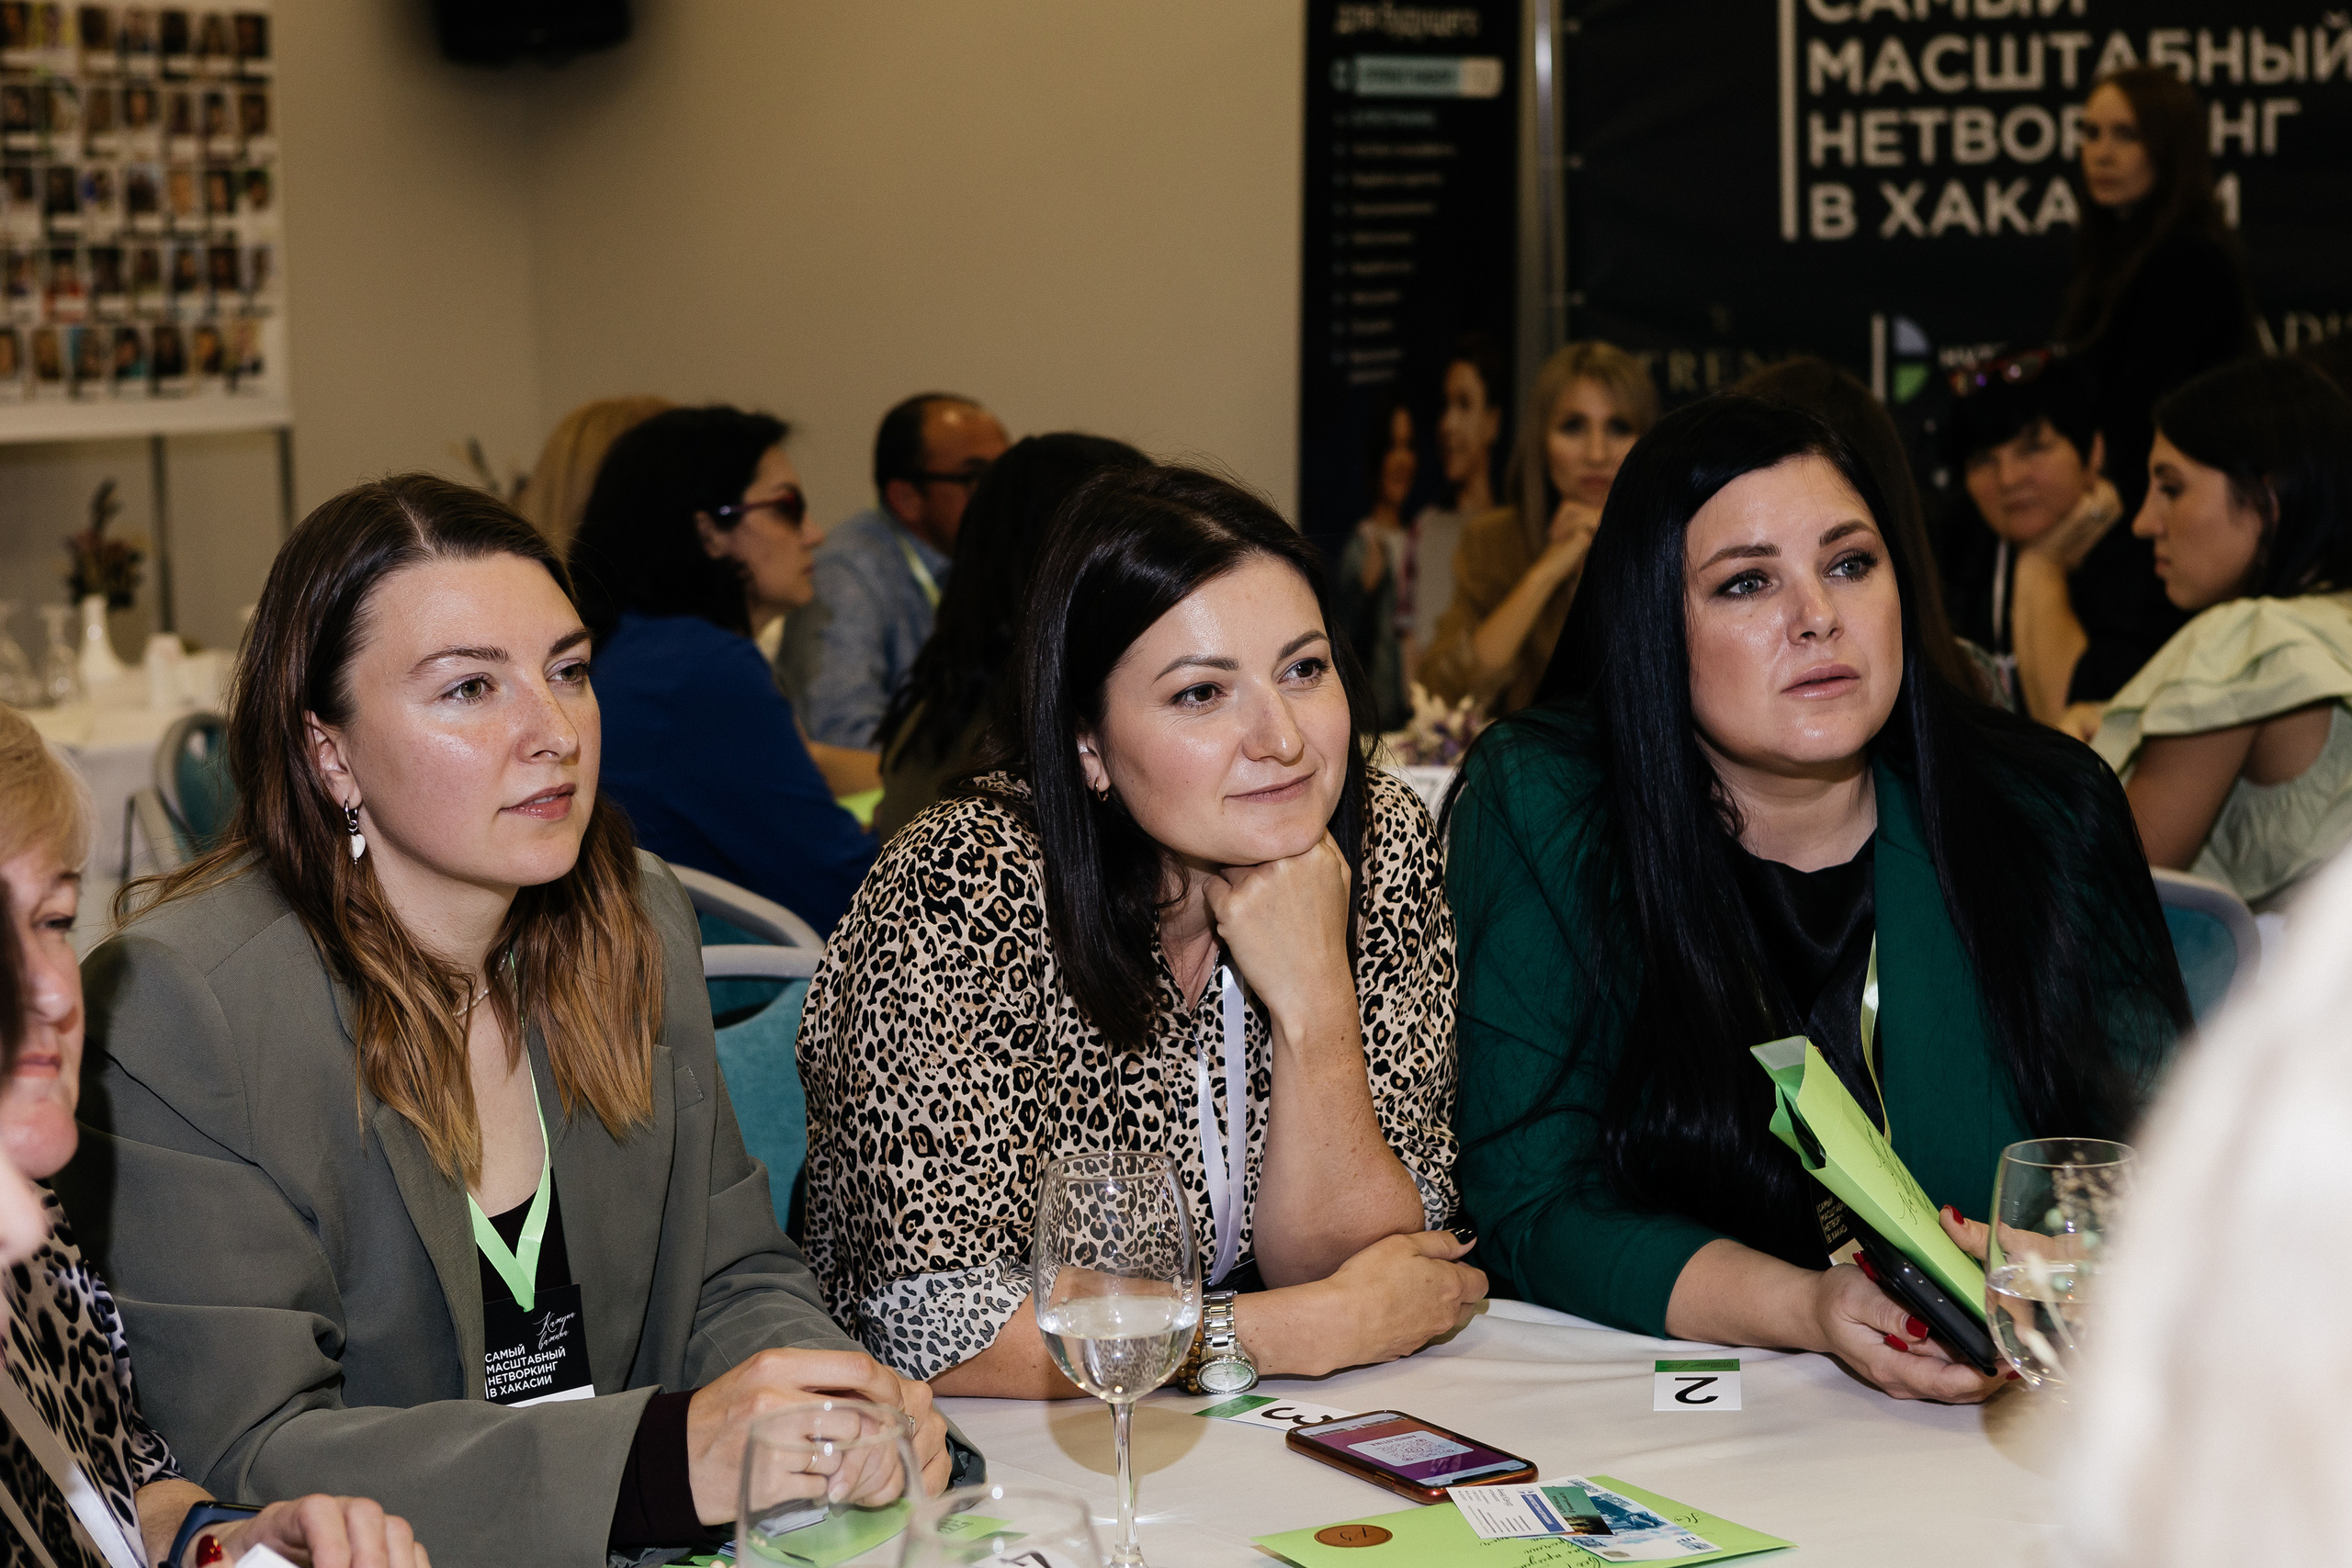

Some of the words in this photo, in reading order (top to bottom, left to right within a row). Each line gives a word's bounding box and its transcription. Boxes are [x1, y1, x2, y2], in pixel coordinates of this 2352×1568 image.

[1806, 11, 2352, 95] МАСШТАБНЫЙ
[1808, 97, 2301, 168] НЕТВОРНГ
[1808, 182, 1859, 241] В
[1880, 172, 2242, 239] ХАКАИ
[485, 1344, 526, 1361] САМЫЙ
[486, 1348, 566, 1374] МАСШТАБНЫЙ
[488, 1361, 558, 1386] НЕТВОРКИНГ
[490, 1386, 498, 1398] В
[499, 1375, 552, 1396] ХАКАСИИ
[1674, 1377, 1719, 1404] 2
[1261, 1406, 1334, 1426] 3
